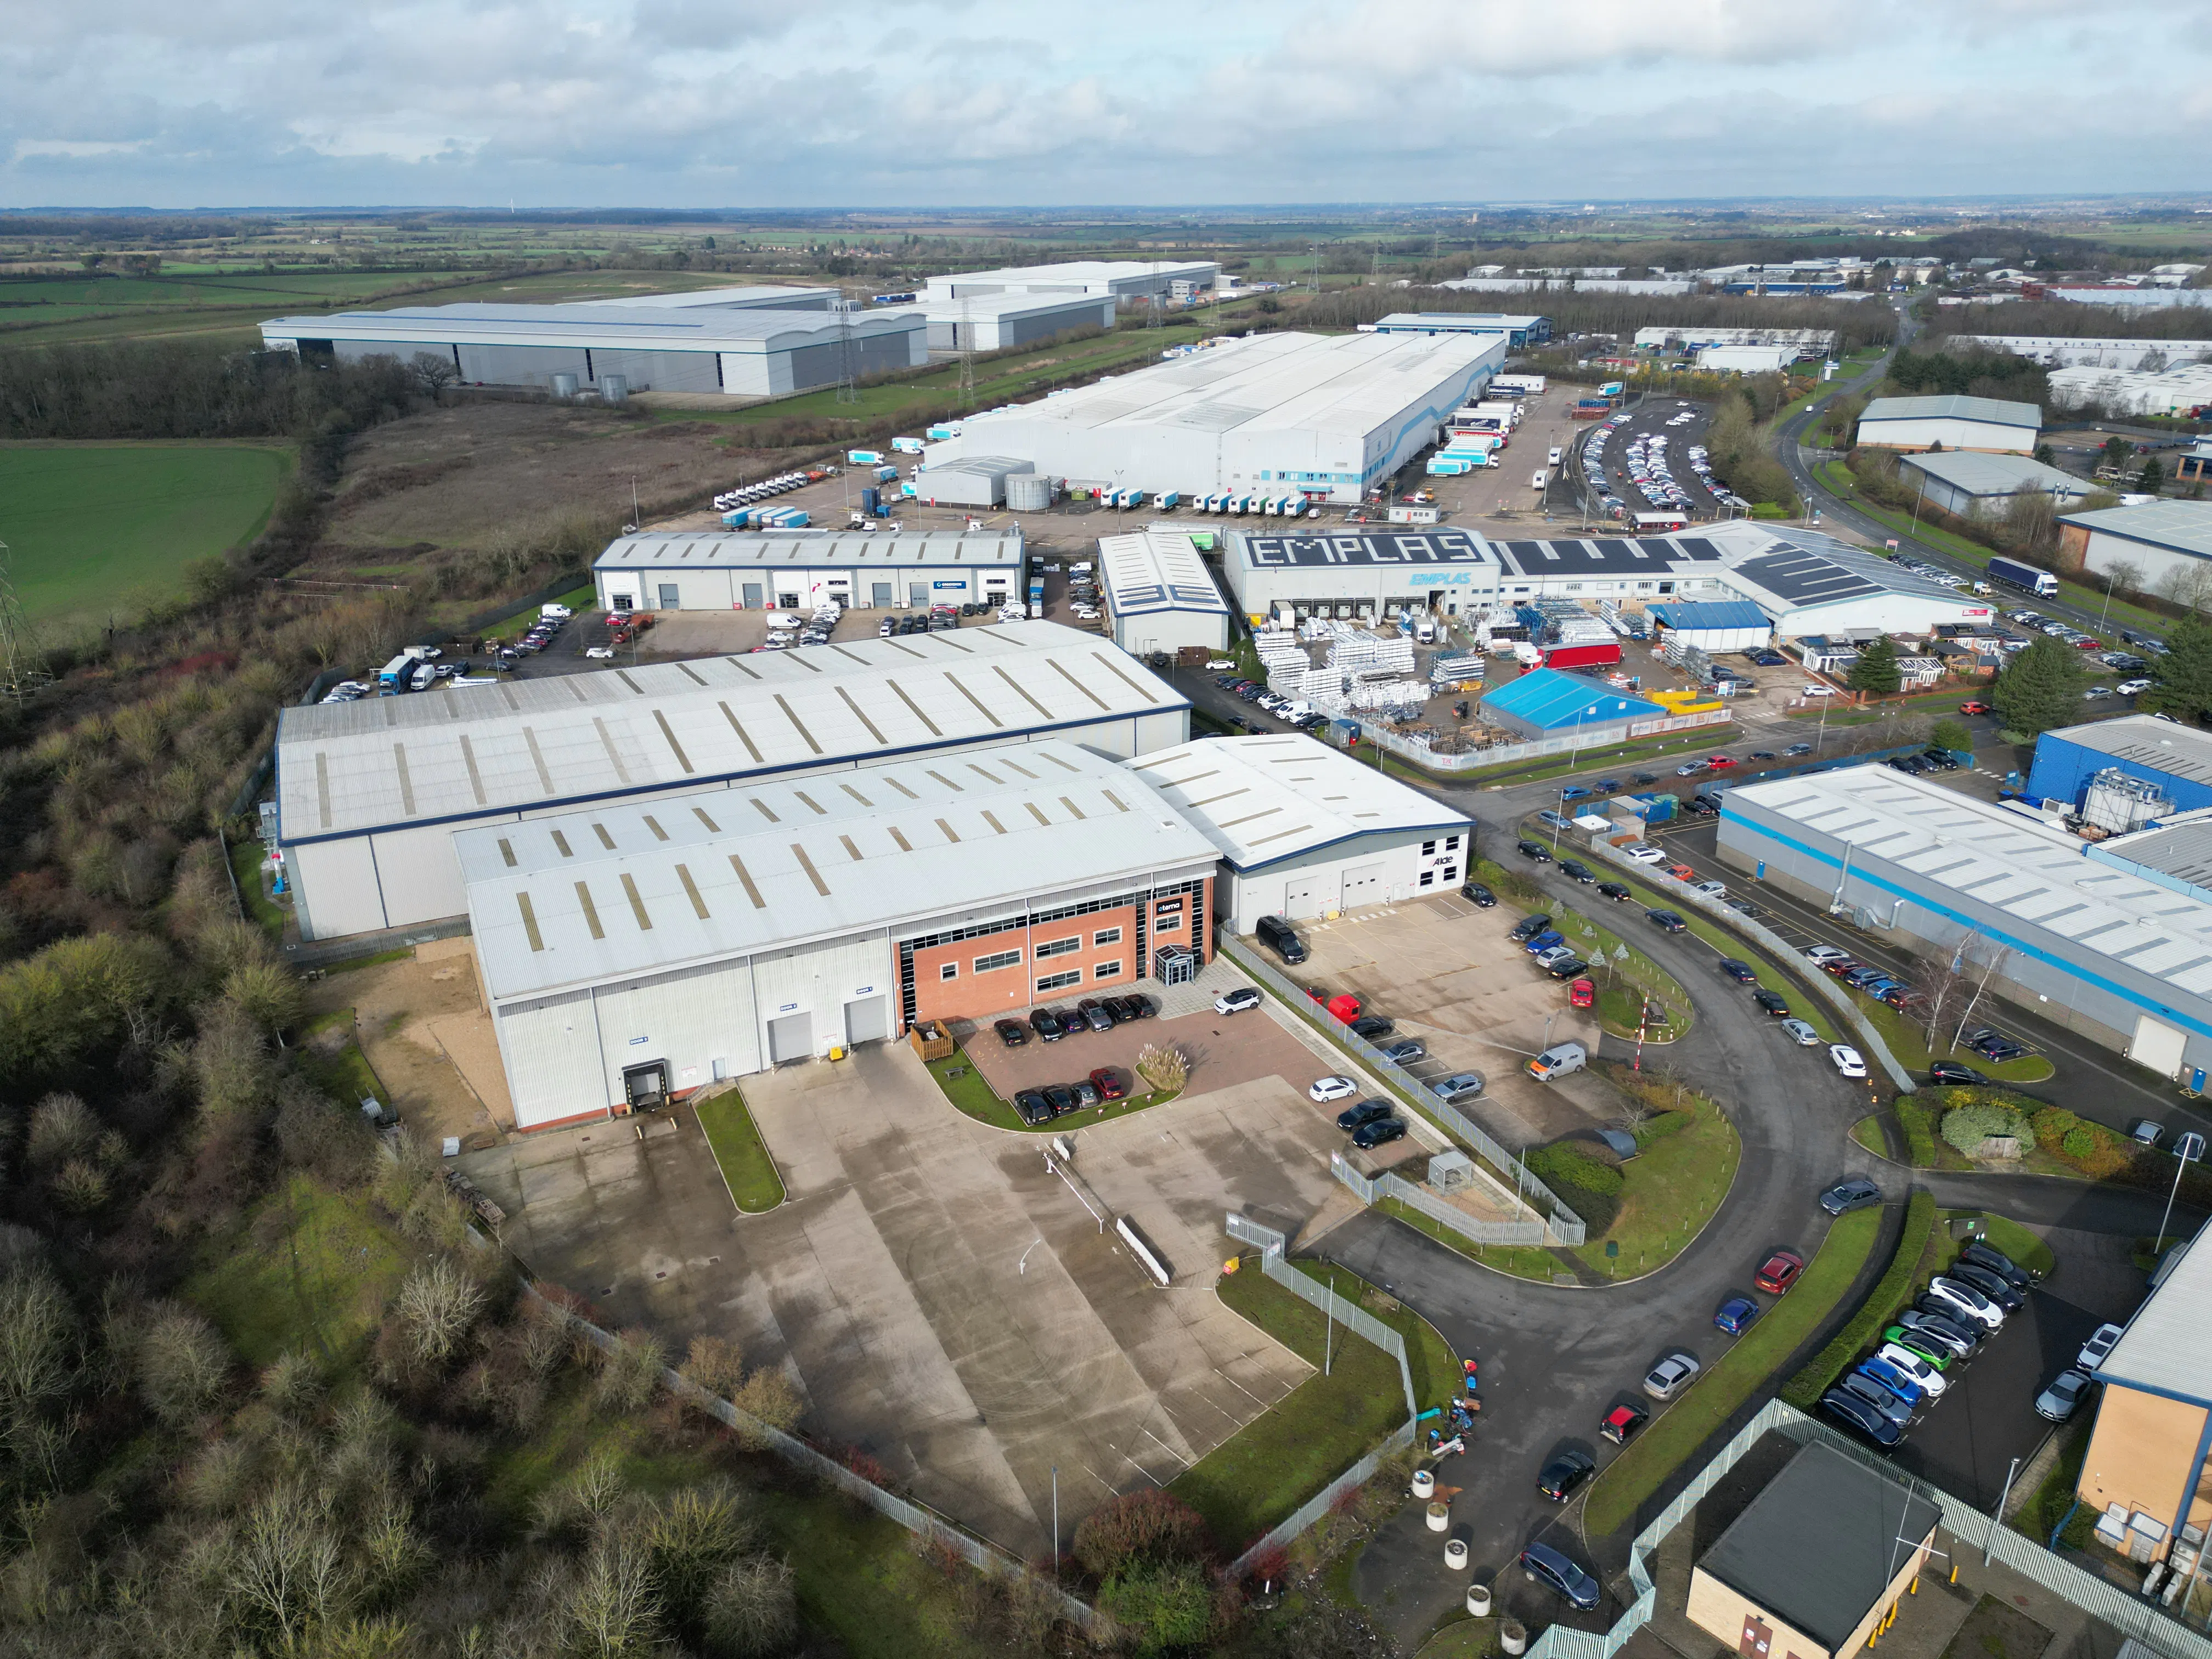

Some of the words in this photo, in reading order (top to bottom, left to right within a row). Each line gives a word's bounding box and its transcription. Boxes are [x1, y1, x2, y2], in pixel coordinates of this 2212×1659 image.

[1252, 535, 1477, 563] EMPLAS
[1409, 572, 1472, 586] EMPLAS
[1432, 856, 1453, 866] Alde
